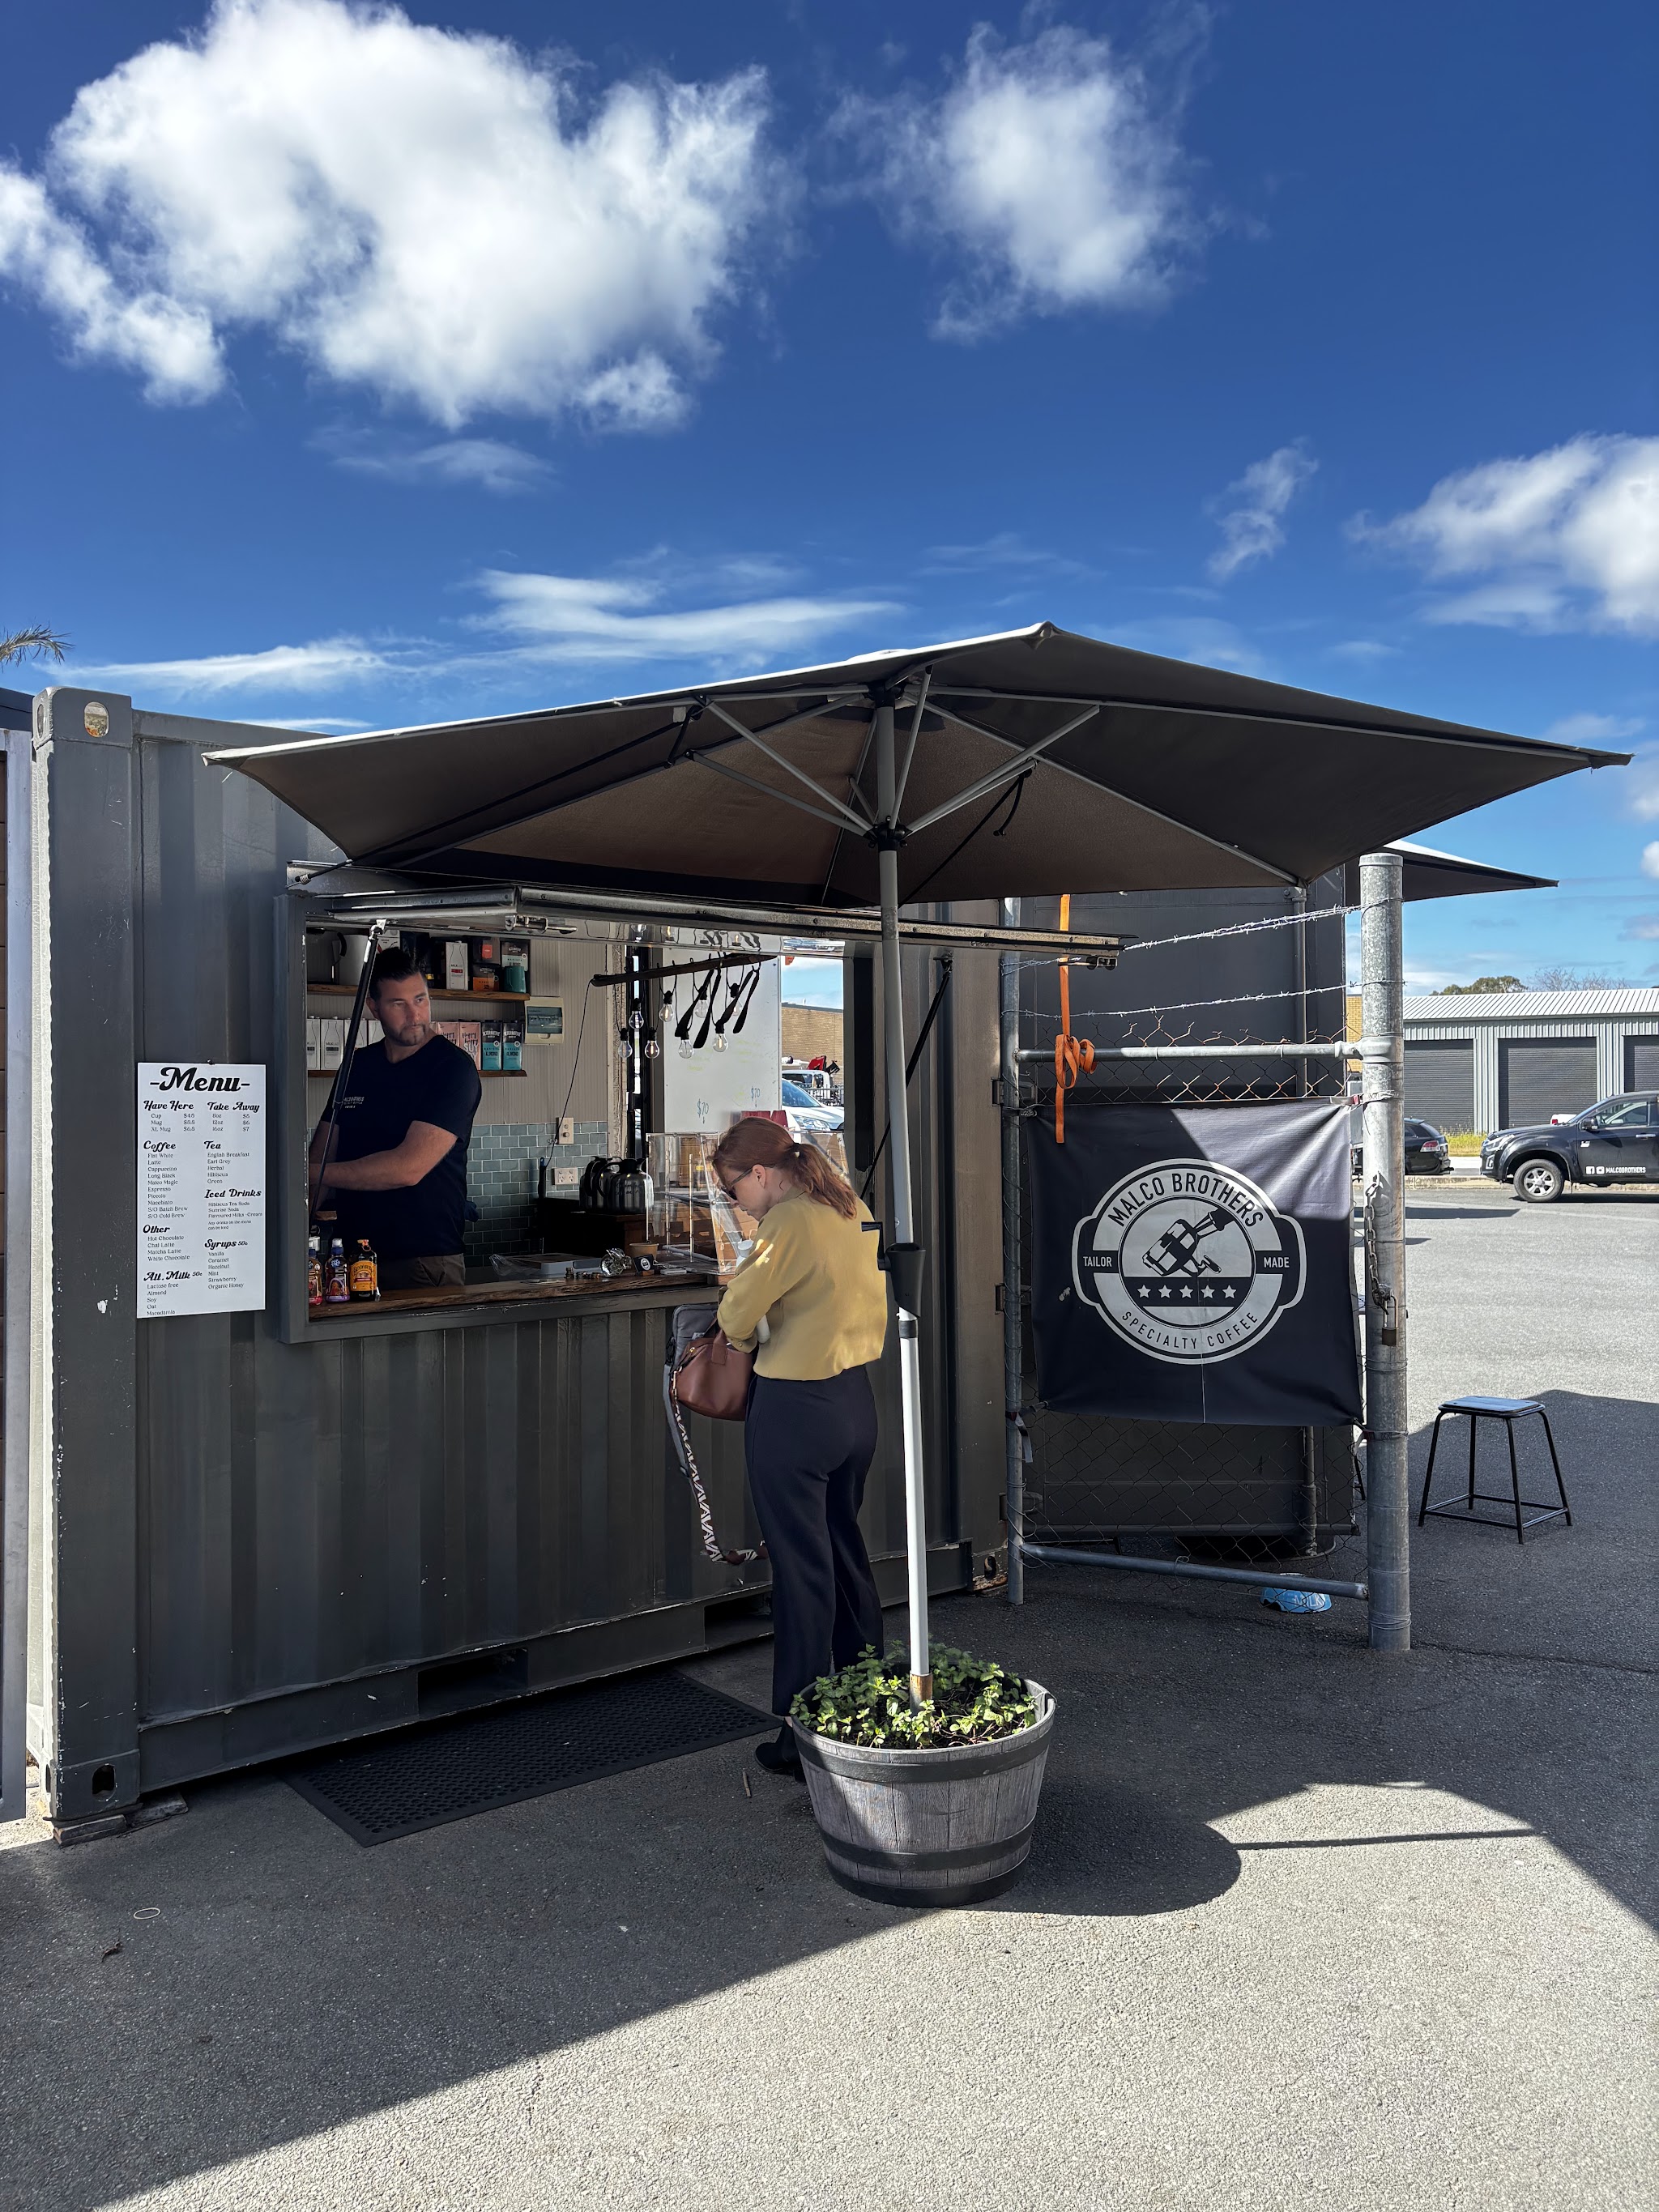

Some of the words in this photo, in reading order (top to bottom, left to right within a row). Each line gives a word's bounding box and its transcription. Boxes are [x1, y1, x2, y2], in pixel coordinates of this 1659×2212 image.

[143, 1100, 168, 1110] Have
[169, 1100, 194, 1110] Here
[207, 1102, 229, 1110] Take
[232, 1102, 260, 1113] Away
[143, 1140, 176, 1152] Coffee
[204, 1140, 221, 1149] Tea
[204, 1189, 226, 1198] Iced
[229, 1189, 262, 1197] Drinks
[1107, 1177, 1164, 1227] MALCO
[1171, 1173, 1264, 1227] BROTHERS
[143, 1225, 170, 1234] Other
[204, 1239, 237, 1250] Syrups
[1082, 1256, 1112, 1267] TAILOR
[1264, 1257, 1290, 1268] MADE
[143, 1272, 164, 1281] Alt.
[166, 1270, 190, 1280] Milk
[1122, 1311, 1197, 1349] SPECIALTY
[1207, 1314, 1258, 1347] COFFEE
